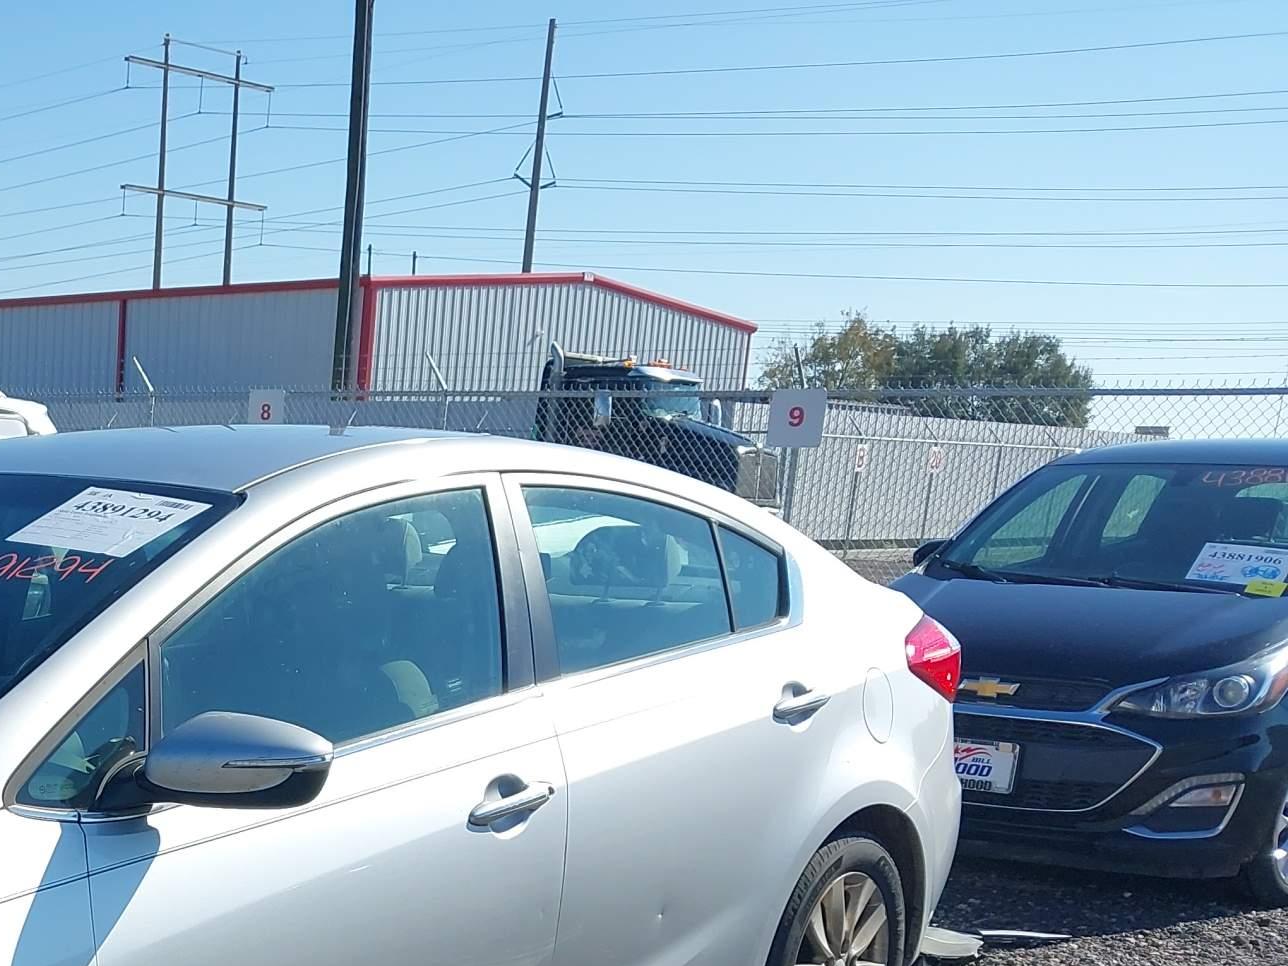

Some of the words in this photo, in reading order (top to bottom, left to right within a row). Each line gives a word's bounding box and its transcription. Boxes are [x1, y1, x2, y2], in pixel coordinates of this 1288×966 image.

[261, 403, 271, 420] 8
[788, 406, 805, 427] 9
[74, 500, 176, 522] 43891294
[1208, 550, 1282, 565] 43881906
[955, 762, 992, 777] OOD
